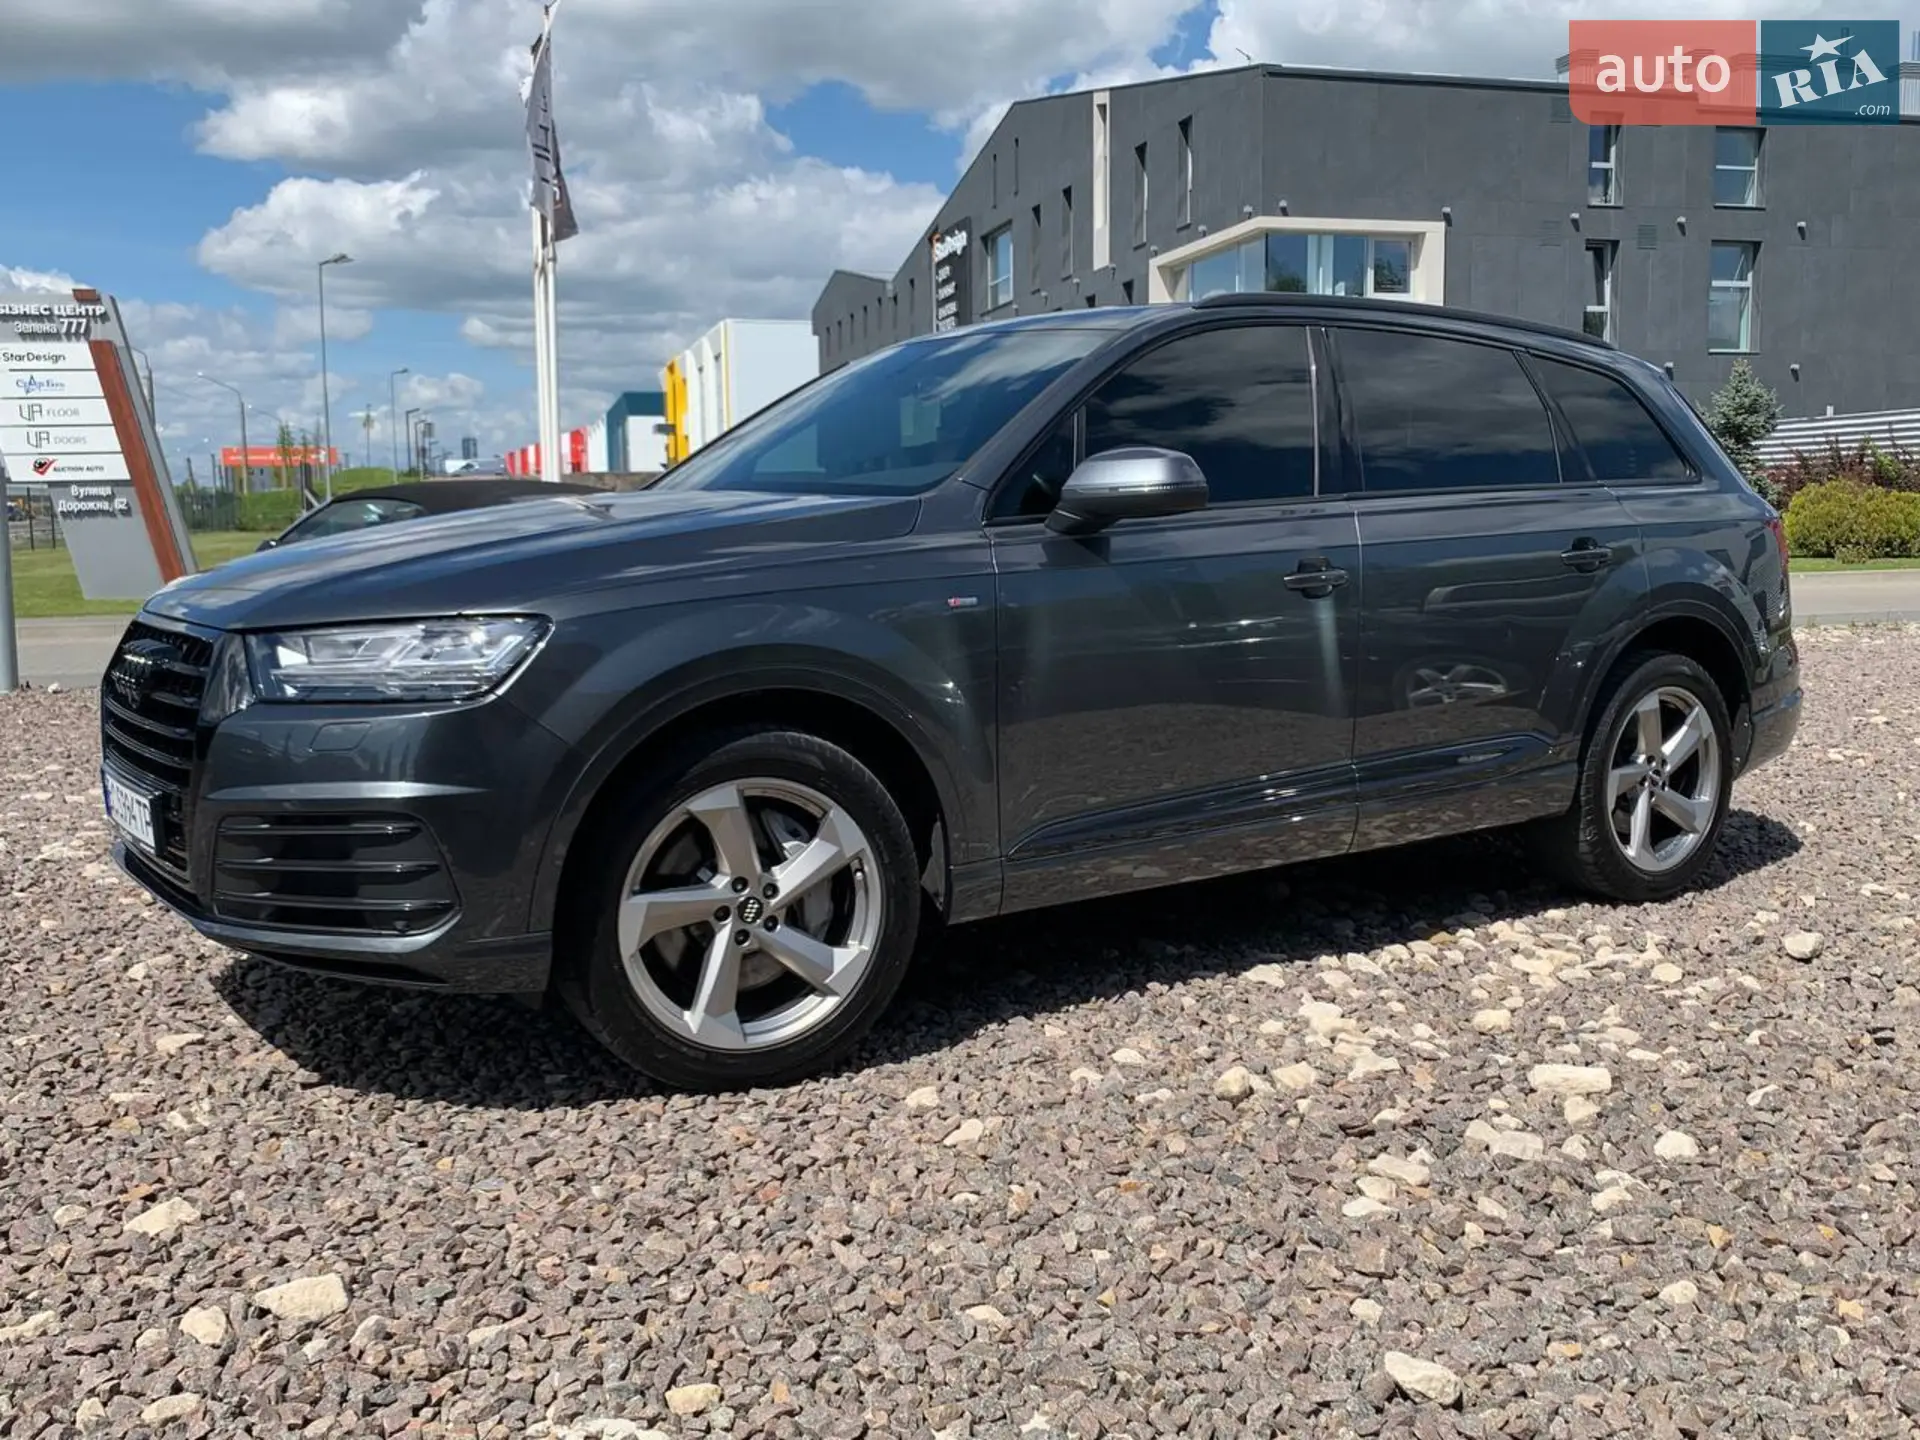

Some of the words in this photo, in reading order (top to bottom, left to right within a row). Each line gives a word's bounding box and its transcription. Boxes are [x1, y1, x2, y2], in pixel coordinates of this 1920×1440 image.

[54, 304, 106, 317] ЦЕНТР
[60, 318, 87, 333] 777
[2, 352, 66, 364] StarDesign
